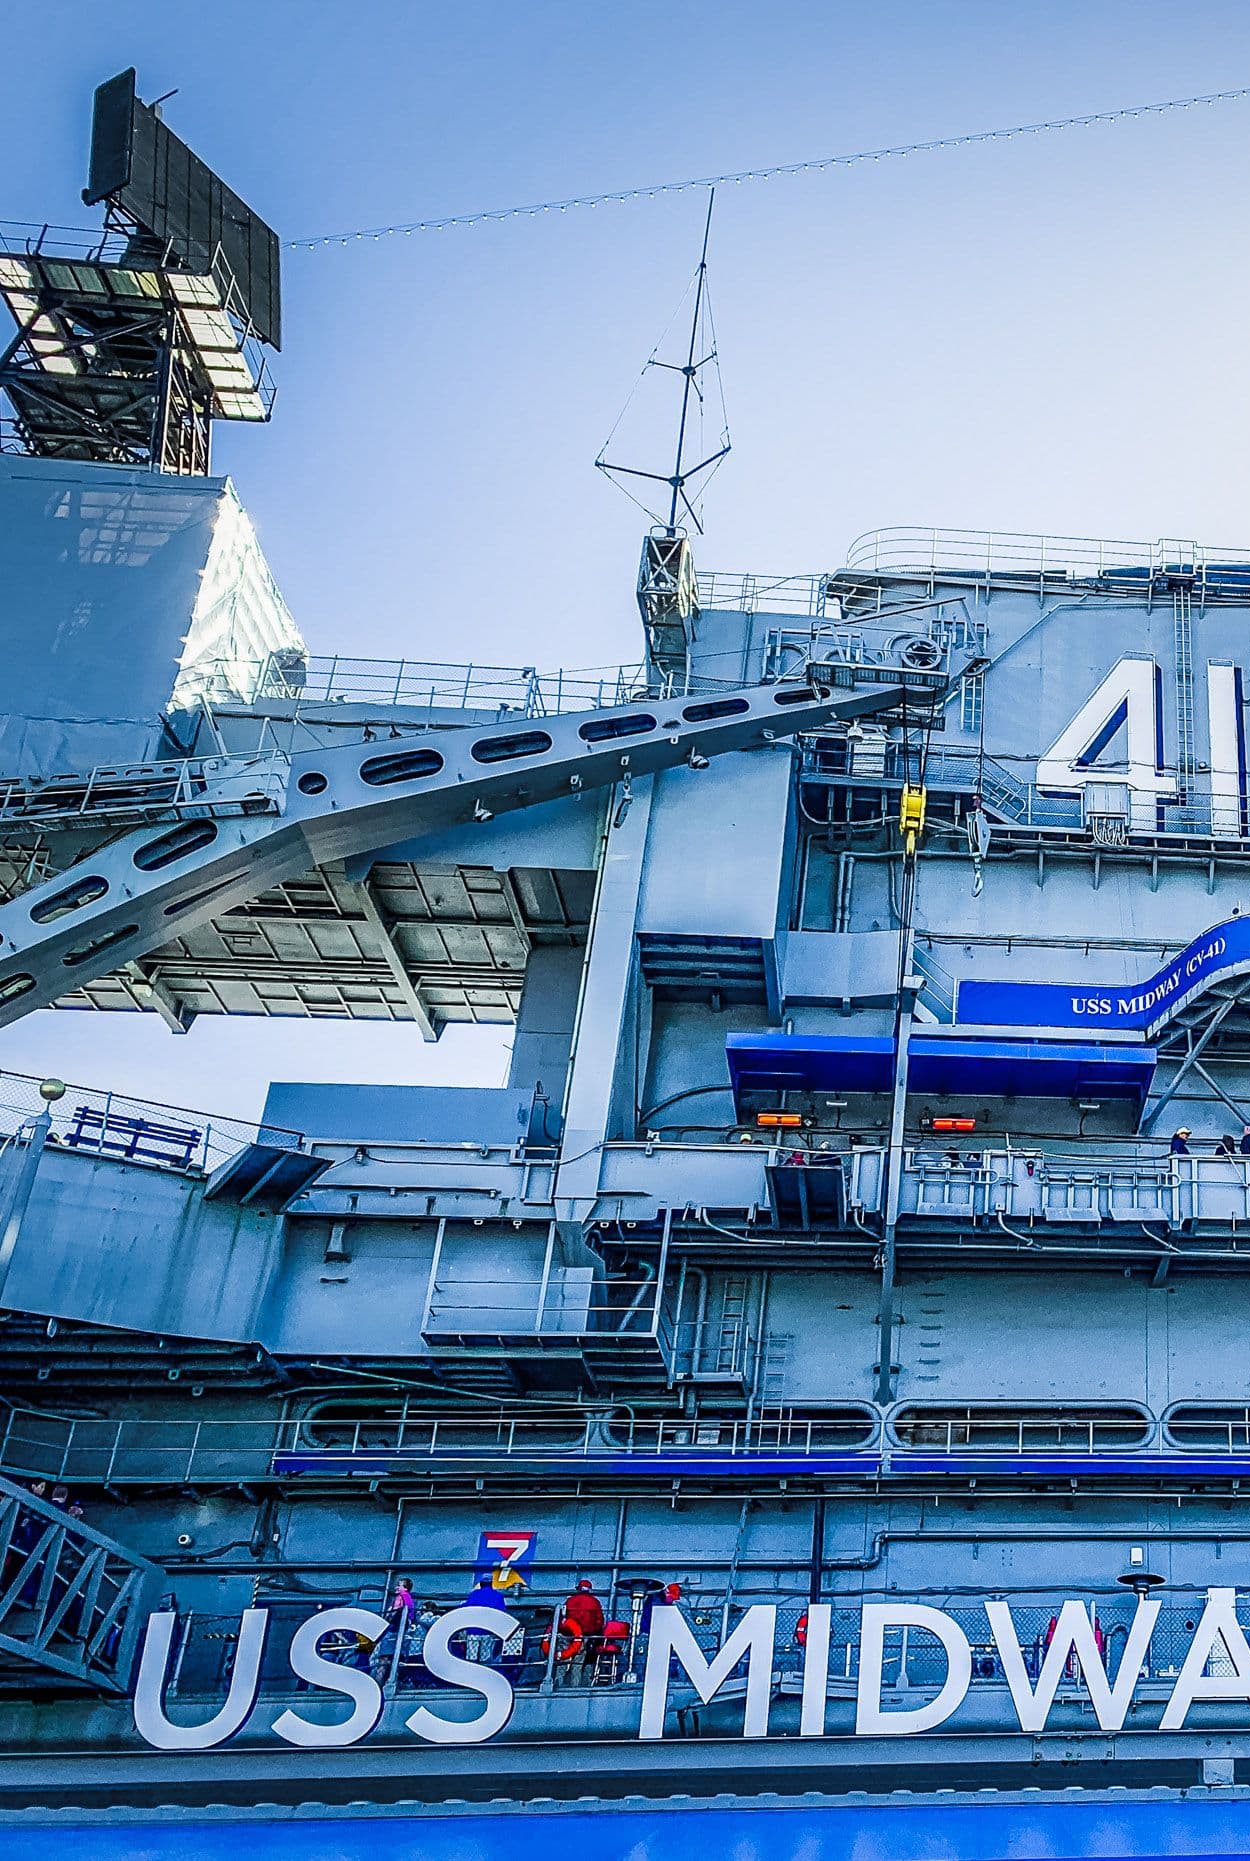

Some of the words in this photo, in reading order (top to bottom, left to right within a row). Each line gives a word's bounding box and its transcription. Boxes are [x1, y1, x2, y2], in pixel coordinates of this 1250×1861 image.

[1037, 651, 1247, 836] 41
[1071, 997, 1112, 1015] USS
[1117, 967, 1181, 1015] MIDWAY
[1185, 937, 1226, 977] (CV-41)
[486, 1539, 530, 1582] 7
[132, 1605, 520, 1751] USS
